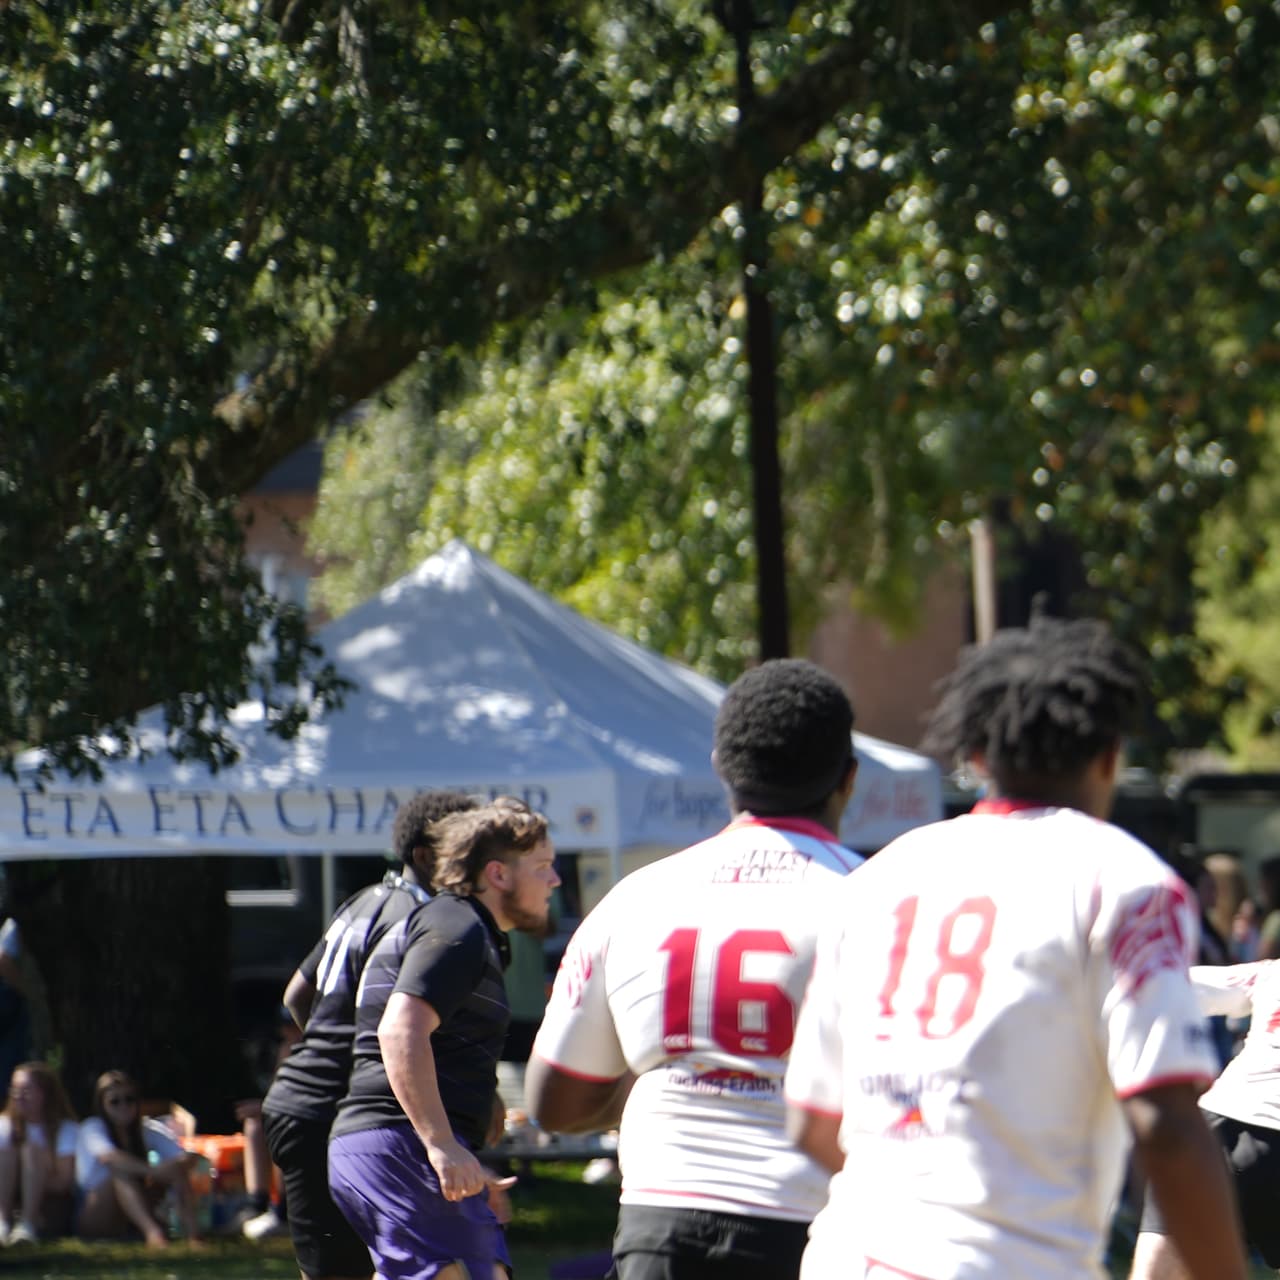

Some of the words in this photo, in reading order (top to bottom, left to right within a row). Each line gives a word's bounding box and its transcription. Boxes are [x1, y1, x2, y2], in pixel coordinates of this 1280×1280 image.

[20, 787, 122, 840] ETA
[148, 783, 254, 834] ETA
[656, 927, 797, 1058] 16
[875, 895, 998, 1042] 18
